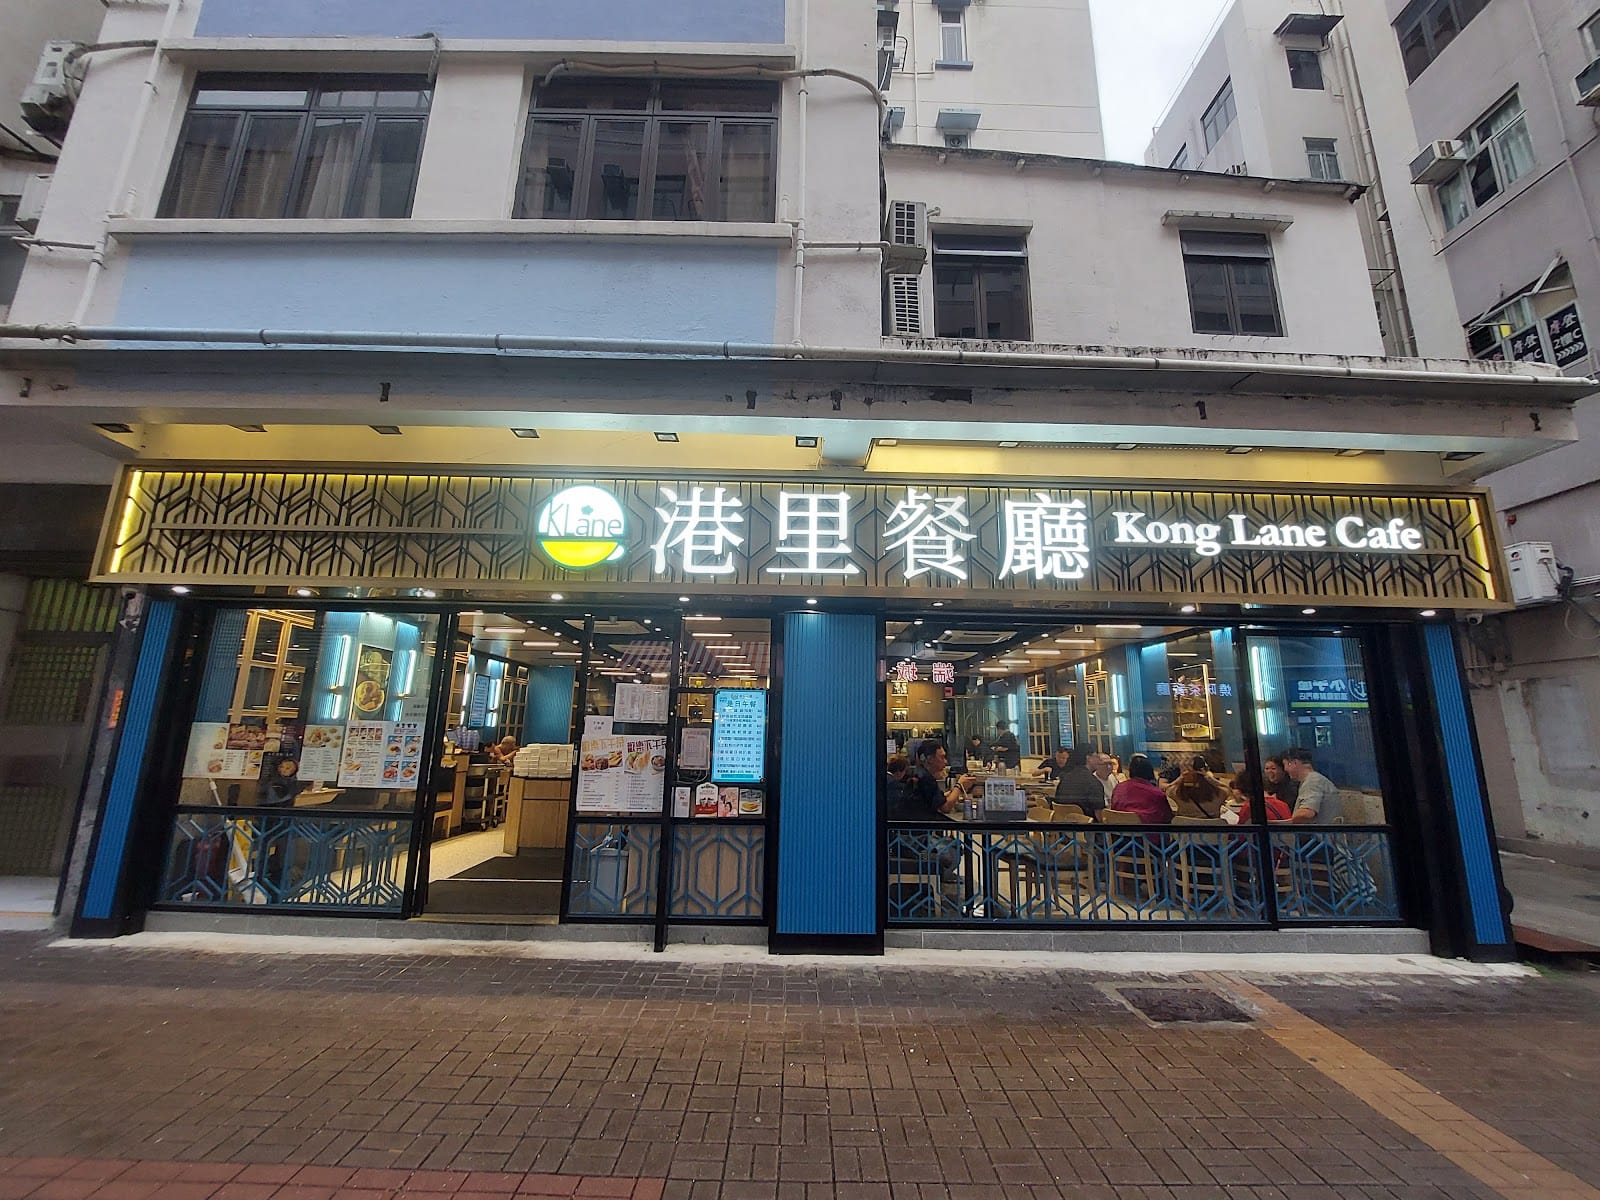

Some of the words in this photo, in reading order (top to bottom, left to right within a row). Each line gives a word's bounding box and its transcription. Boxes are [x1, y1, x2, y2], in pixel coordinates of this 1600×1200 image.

[650, 486, 1090, 580] 港里餐廳
[1112, 511, 1221, 556] Kong
[1228, 513, 1326, 547] Lane
[1335, 516, 1422, 550] Cafe
